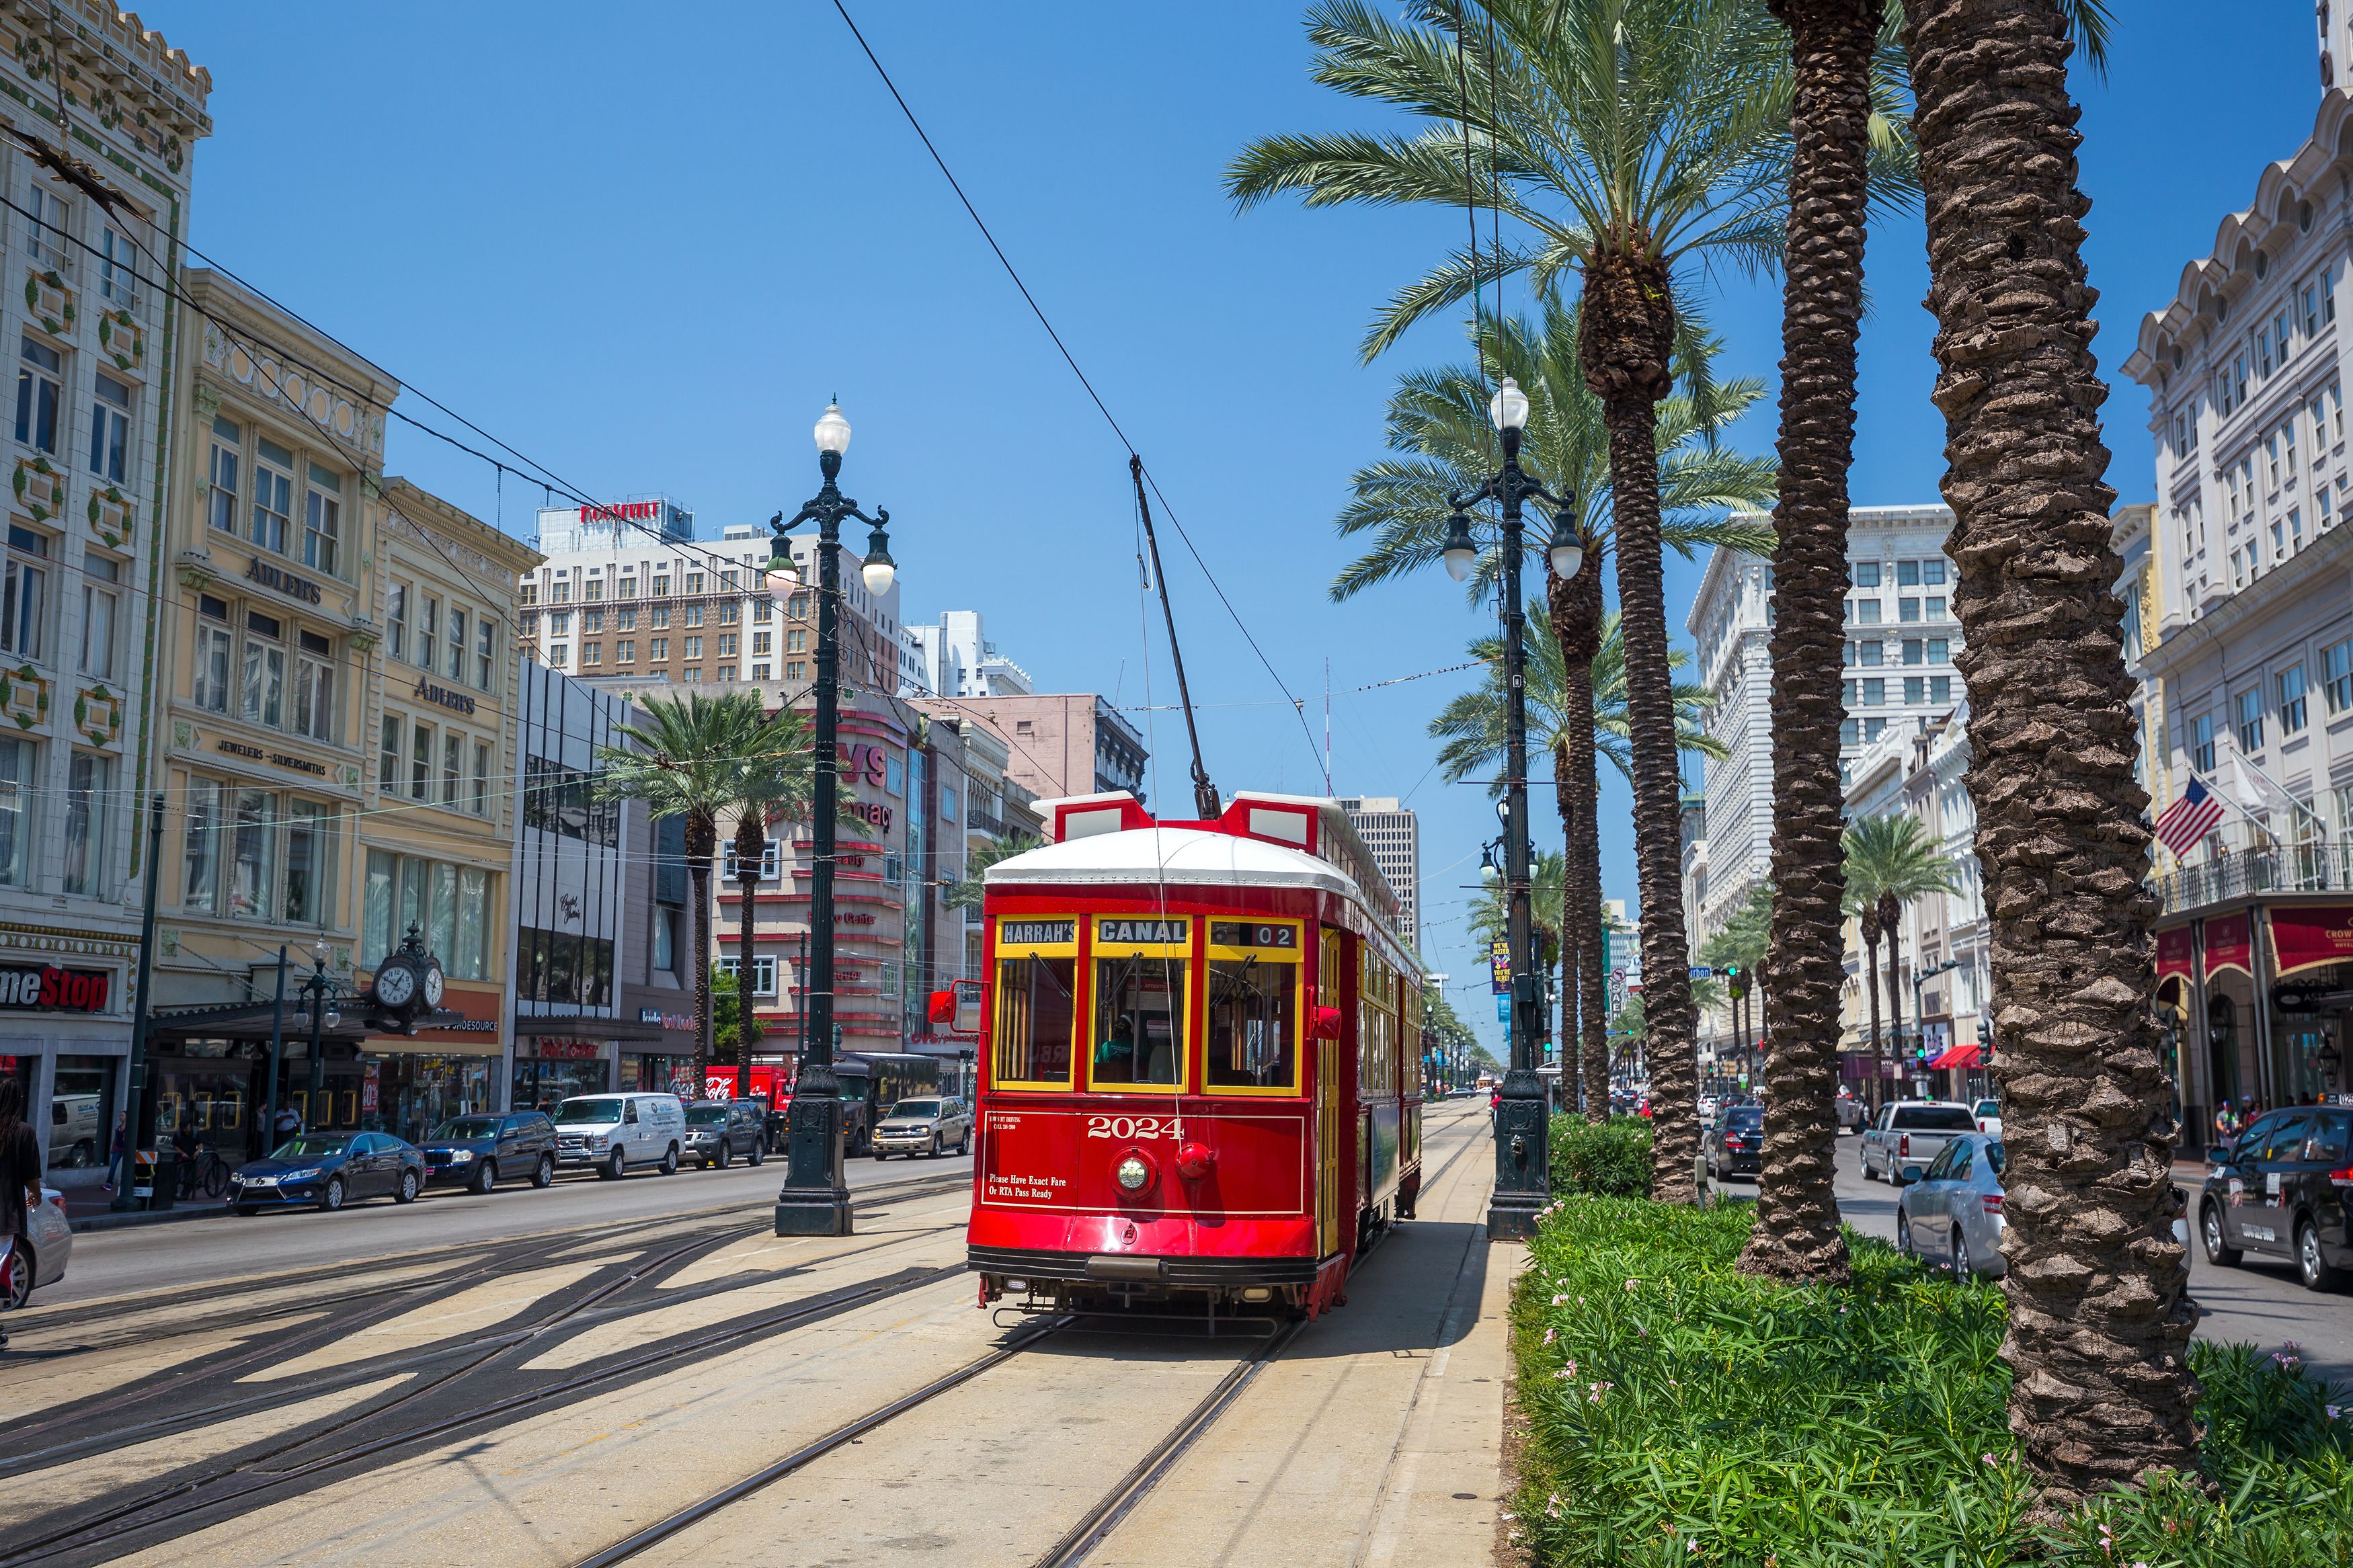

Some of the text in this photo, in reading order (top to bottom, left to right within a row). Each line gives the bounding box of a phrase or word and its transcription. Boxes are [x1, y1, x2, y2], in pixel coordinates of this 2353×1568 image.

[246, 556, 321, 605] ADLER'S
[414, 676, 475, 714] ADLER'S
[218, 740, 263, 760] JEWELERS
[272, 753, 325, 776] SILVERSMITHS
[765, 798, 893, 834] pmacy
[835, 856, 865, 868] eauty
[845, 912, 876, 924] Center
[1004, 923, 1074, 943] HARRAH'S
[1100, 921, 1186, 941] CANAL
[1259, 927, 1289, 945] 02
[2325, 930, 2353, 939] CROW
[834, 968, 861, 980] iquor
[1689, 968, 1709, 977] urbon
[0, 967, 108, 1012] meStop
[1612, 983, 1620, 1021] SAEN
[678, 1014, 697, 1032] Lock
[1088, 1116, 1185, 1140] 2024
[989, 1173, 1066, 1186] Please Have Exact Fare
[989, 1186, 1052, 1200] Or RTA Pass Ready
